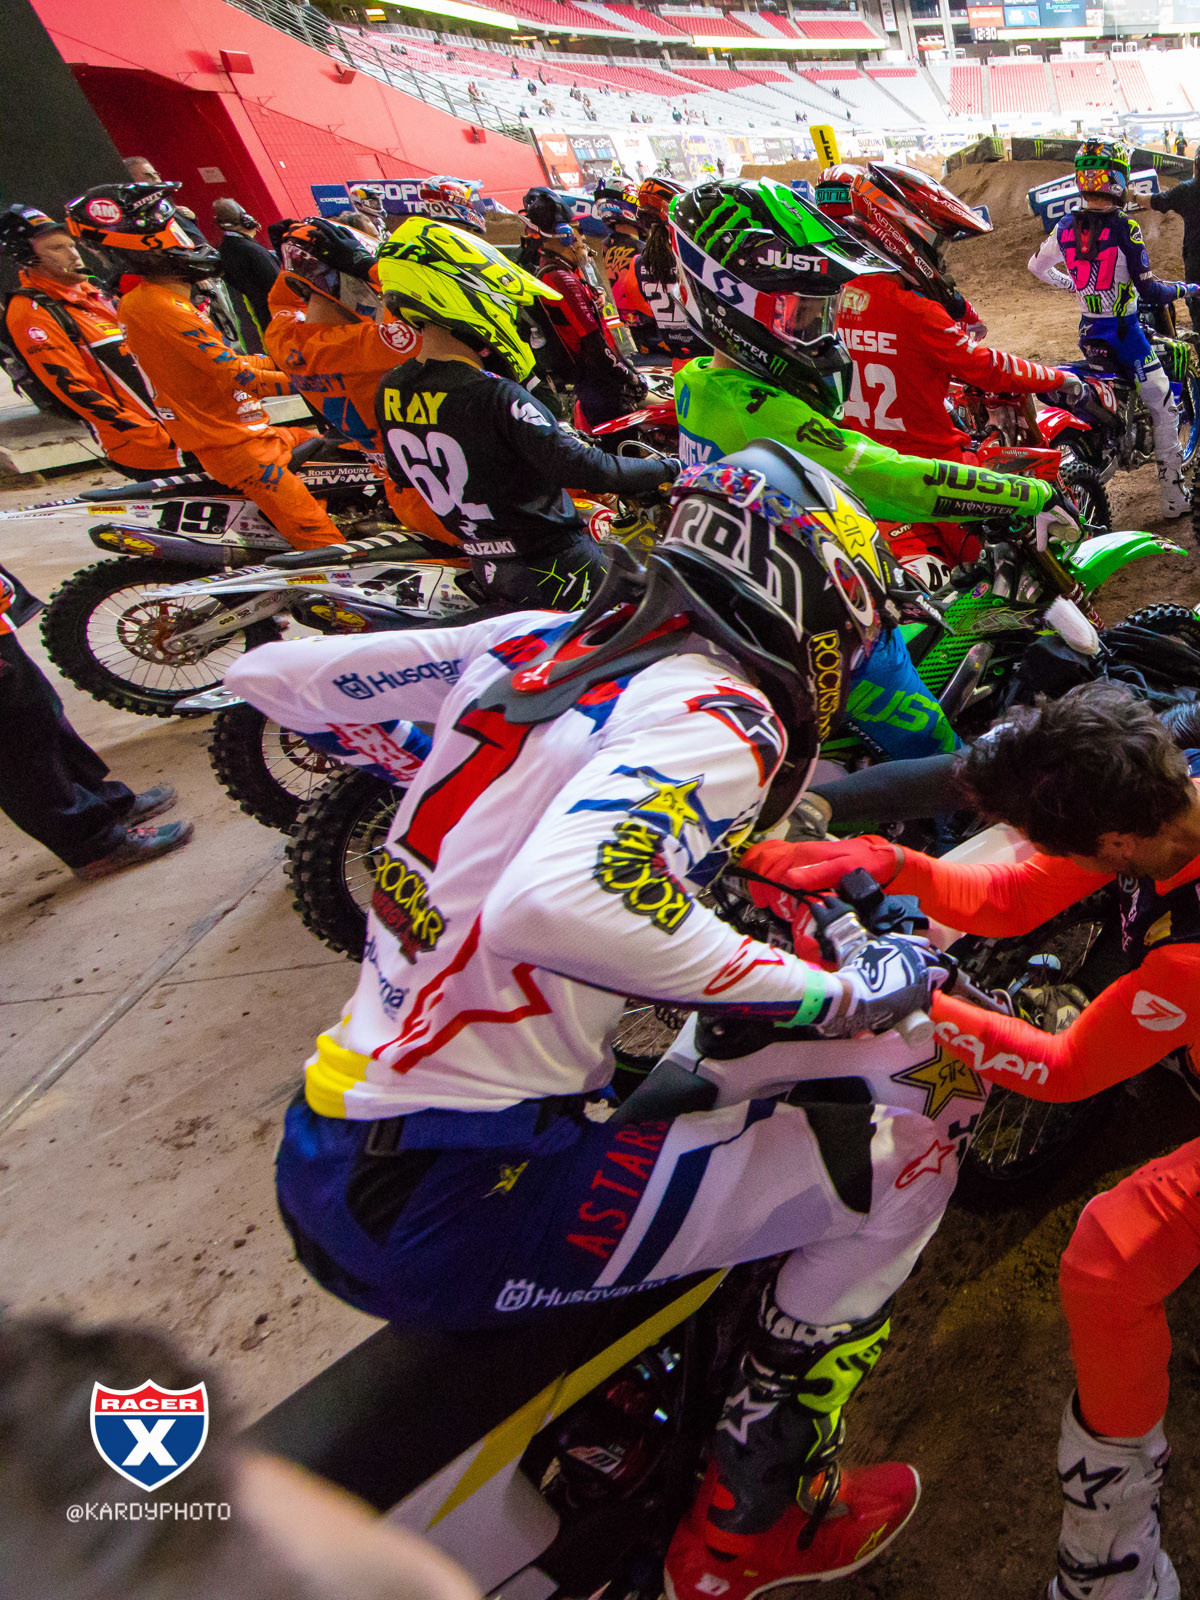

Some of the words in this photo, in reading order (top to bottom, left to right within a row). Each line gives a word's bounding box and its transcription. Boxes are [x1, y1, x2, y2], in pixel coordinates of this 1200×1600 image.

[974, 27, 997, 40] 12:30
[570, 138, 592, 149] GoPro
[757, 248, 829, 275] JUST1
[703, 307, 768, 364] MONSTER
[384, 387, 448, 425] RAY
[308, 468, 336, 477] ROCKY
[387, 428, 494, 521] 62
[152, 501, 231, 534] 19
[954, 501, 1015, 516] MONSTER
[462, 539, 517, 557] SUZUKI
